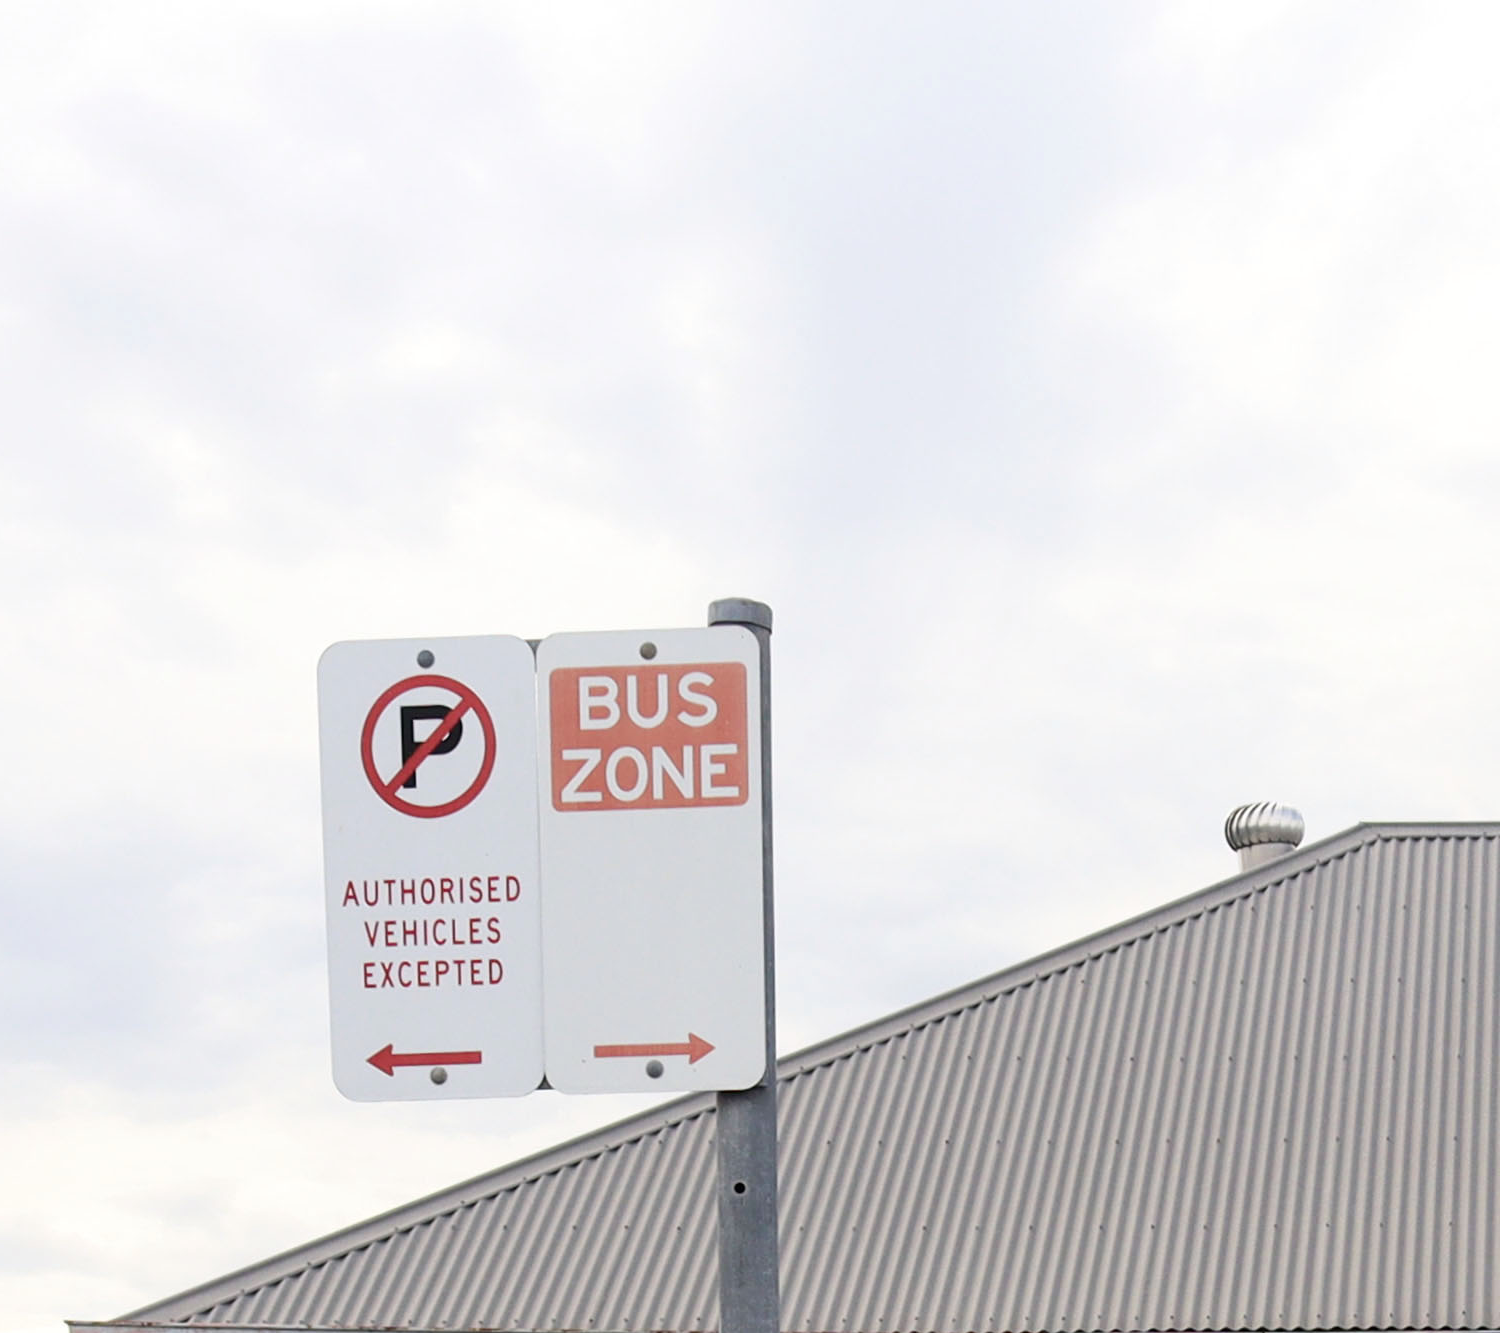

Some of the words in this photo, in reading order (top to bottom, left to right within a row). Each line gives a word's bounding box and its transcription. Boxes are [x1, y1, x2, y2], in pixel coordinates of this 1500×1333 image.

[578, 672, 718, 730] BUS
[400, 704, 463, 789] P
[561, 743, 739, 803] ZONE
[343, 876, 521, 907] AUTHORISED
[365, 917, 502, 947] VEHICLES
[363, 959, 504, 989] EXCEPTED
